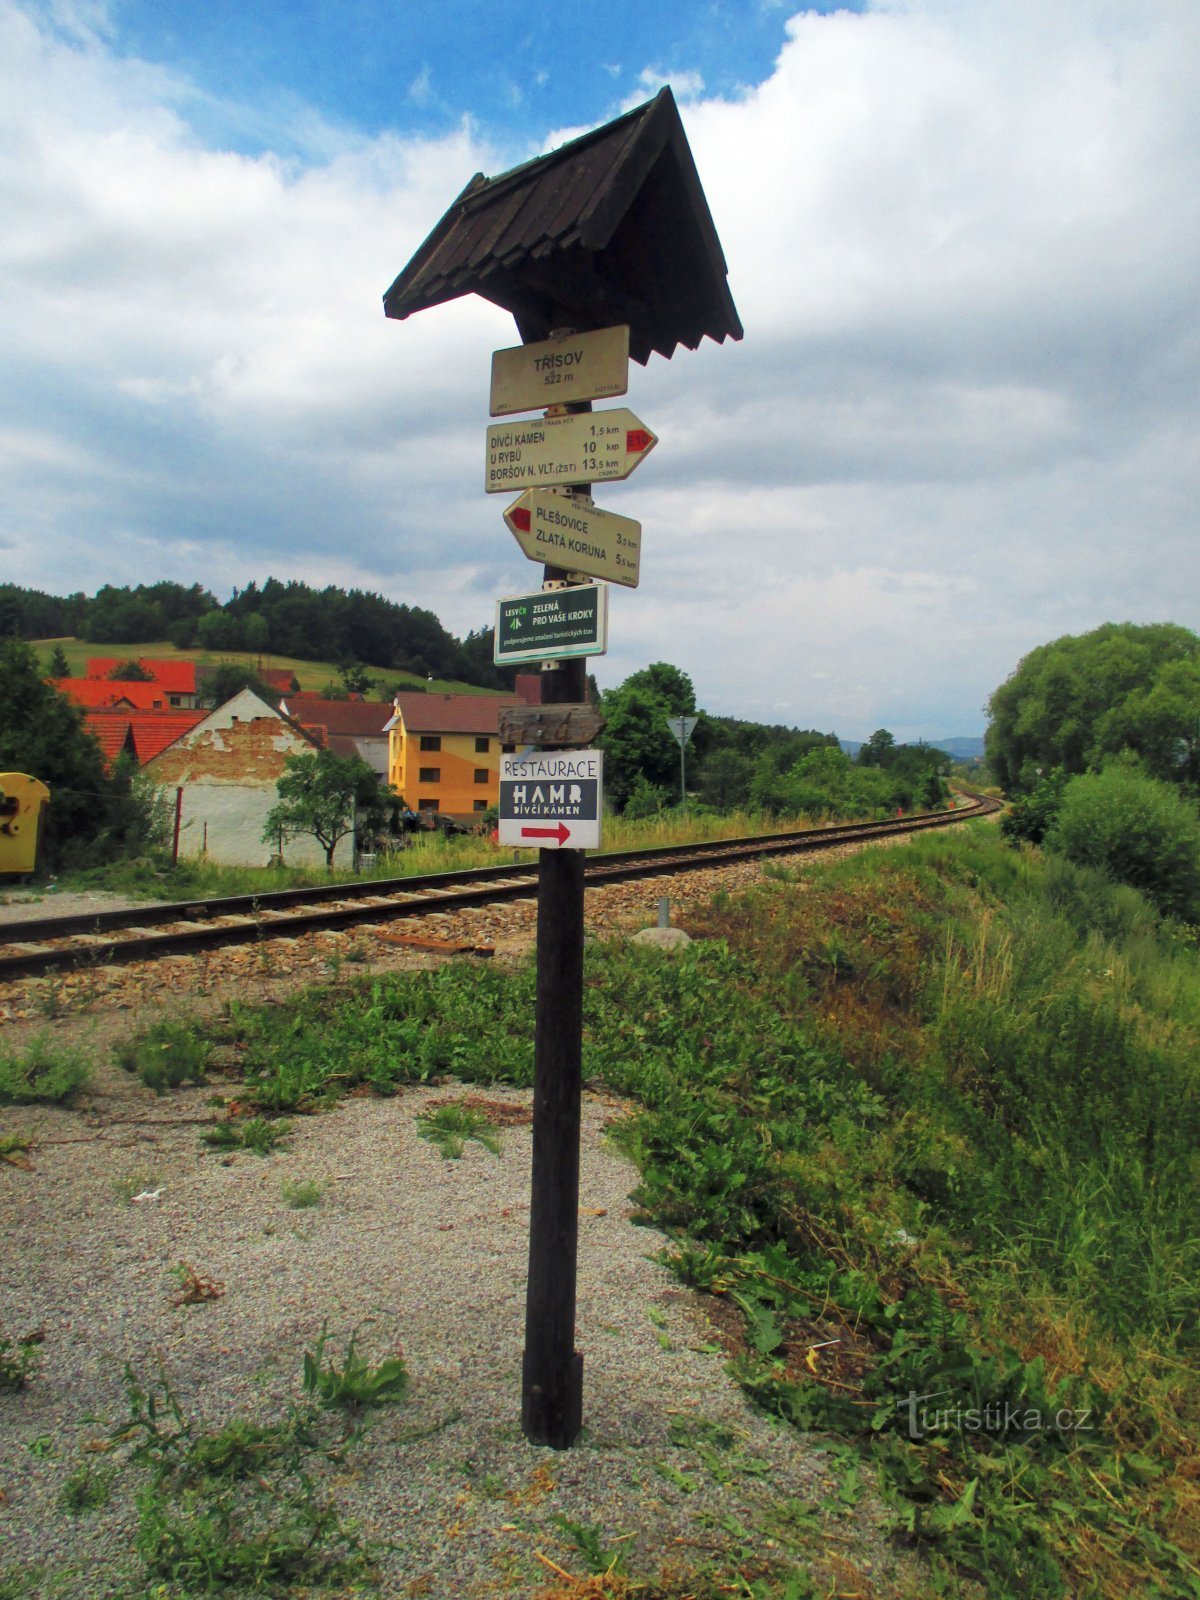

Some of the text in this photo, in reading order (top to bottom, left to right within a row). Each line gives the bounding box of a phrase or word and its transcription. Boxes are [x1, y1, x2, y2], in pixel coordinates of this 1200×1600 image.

[534, 350, 584, 372] TŘÍSOV
[544, 373, 574, 385] 522 m
[491, 424, 619, 449] DÍVČÍ KÁMEN 1,5 km
[490, 454, 497, 465] U
[583, 441, 597, 454] 10
[606, 442, 619, 451] km
[490, 465, 526, 481] BORŠOV
[527, 466, 537, 477] N.
[582, 458, 604, 472] 13,5
[605, 459, 619, 468] km
[536, 507, 589, 534] PLEŠOVICE
[568, 539, 607, 561] KORUNA
[627, 539, 638, 549] km
[626, 560, 637, 569] km
[532, 600, 560, 614] ZELENÁ
[532, 608, 594, 626] PRO VAŠE KROKY
[504, 760, 597, 778] RESTAURACE
[513, 784, 582, 804] HAMR
[513, 803, 580, 815] DÍVČÍ KÁMEN
